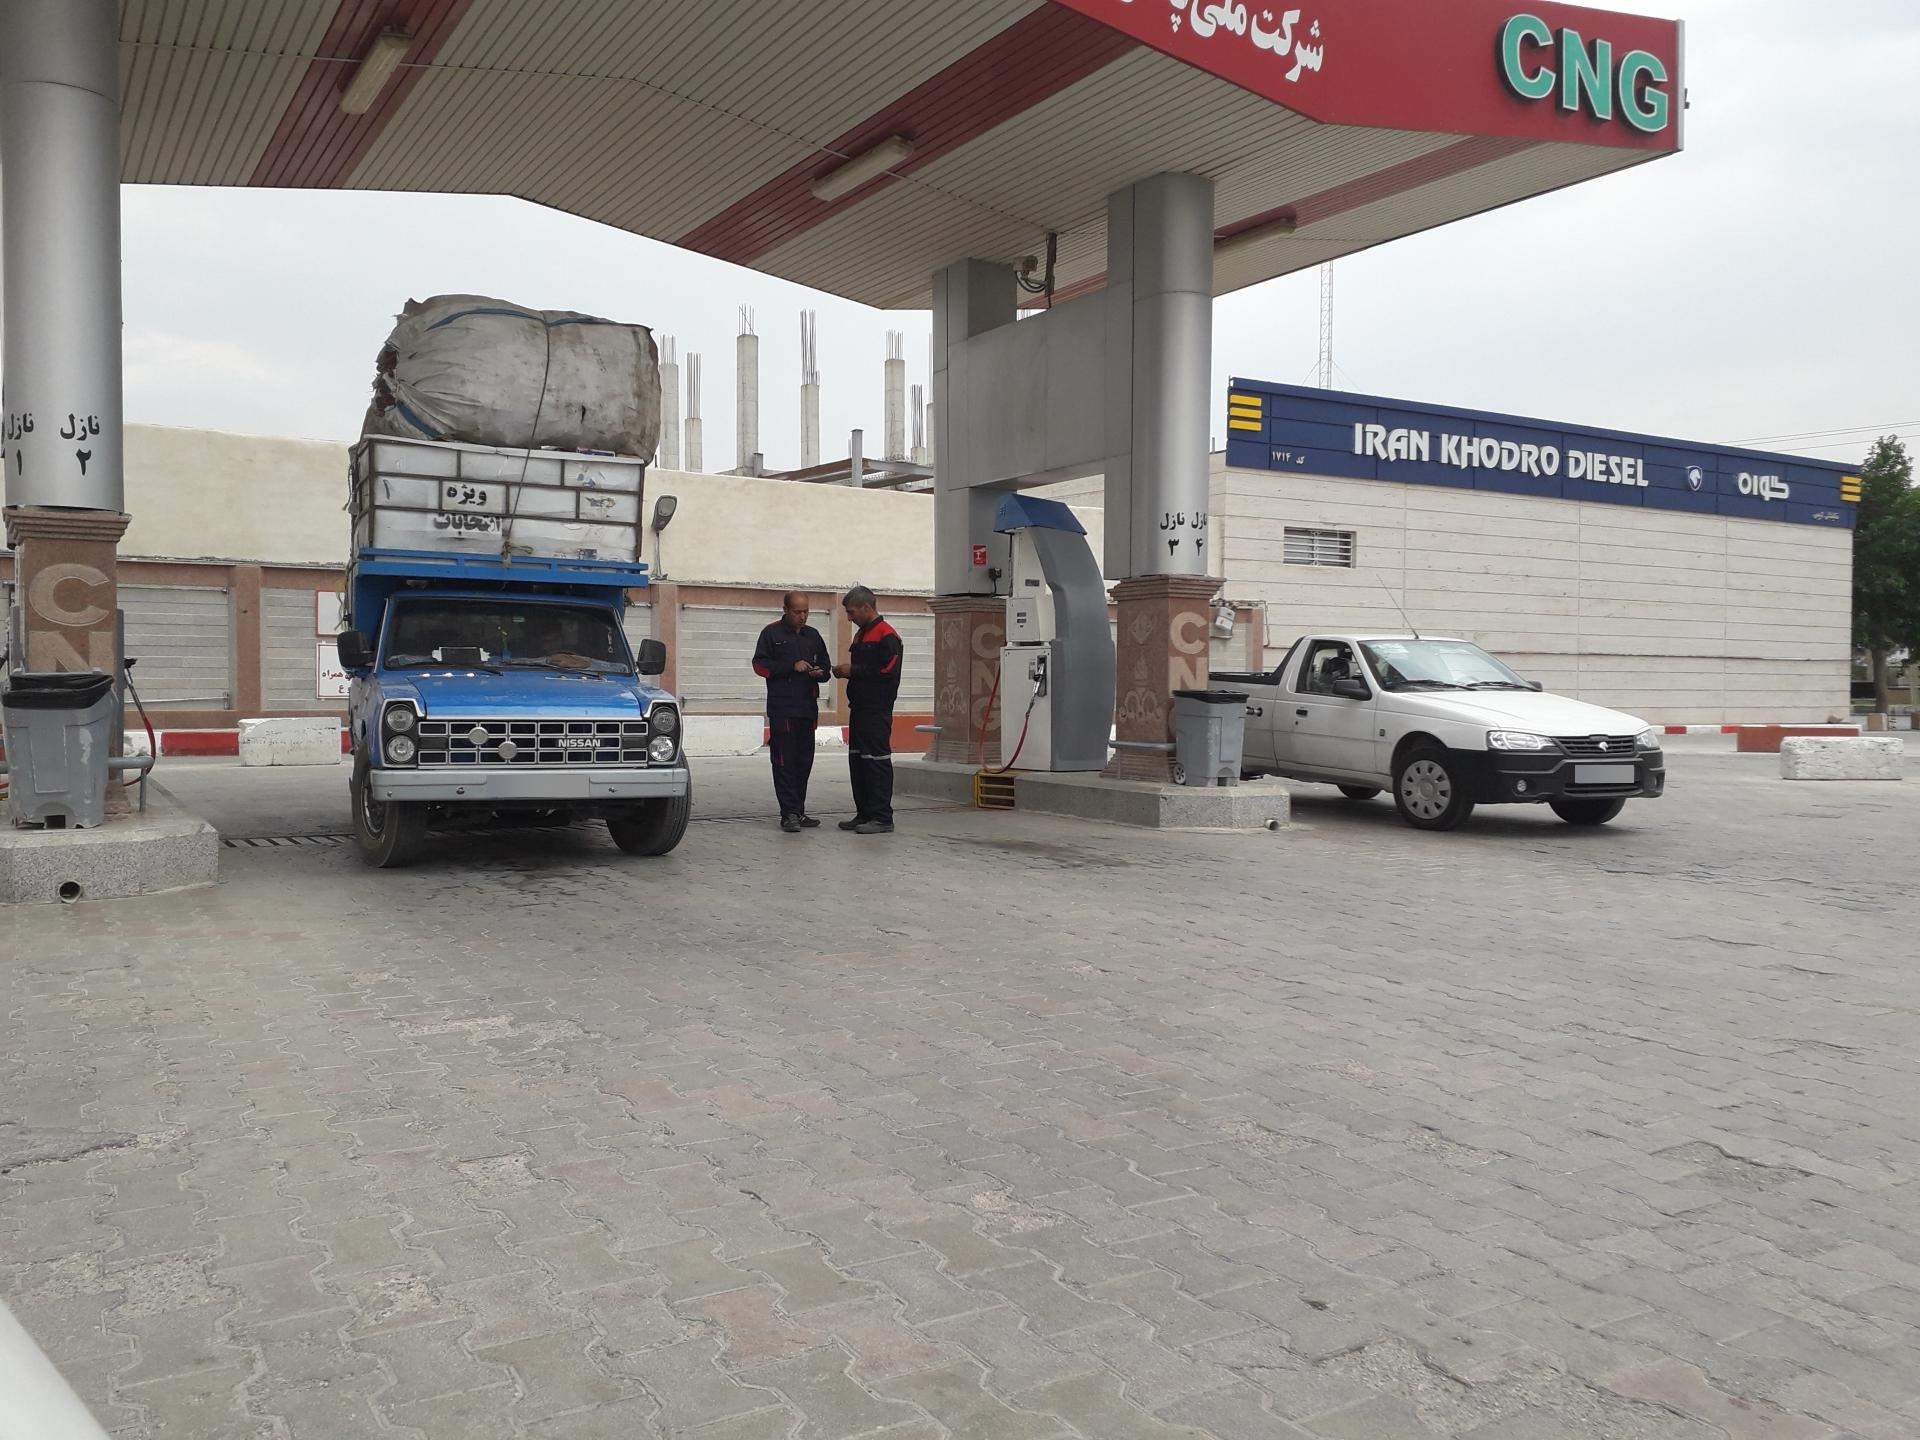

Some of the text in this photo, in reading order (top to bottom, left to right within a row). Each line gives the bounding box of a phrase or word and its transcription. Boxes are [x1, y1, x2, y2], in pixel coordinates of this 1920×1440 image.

[1250, 9, 1324, 82] شرکت
[1500, 13, 1669, 133] CNG
[7, 412, 34, 440] نازل
[59, 413, 100, 441] نازل
[75, 448, 92, 476] ۲
[1354, 422, 1649, 487] IRAN KHODRO DIESEL
[446, 483, 487, 506] ویژه
[1159, 511, 1185, 531] نازل
[1167, 538, 1180, 557] ۳
[1195, 537, 1204, 557] ۴
[322, 669, 344, 680] همراه
[558, 738, 601, 748] NISSAN
